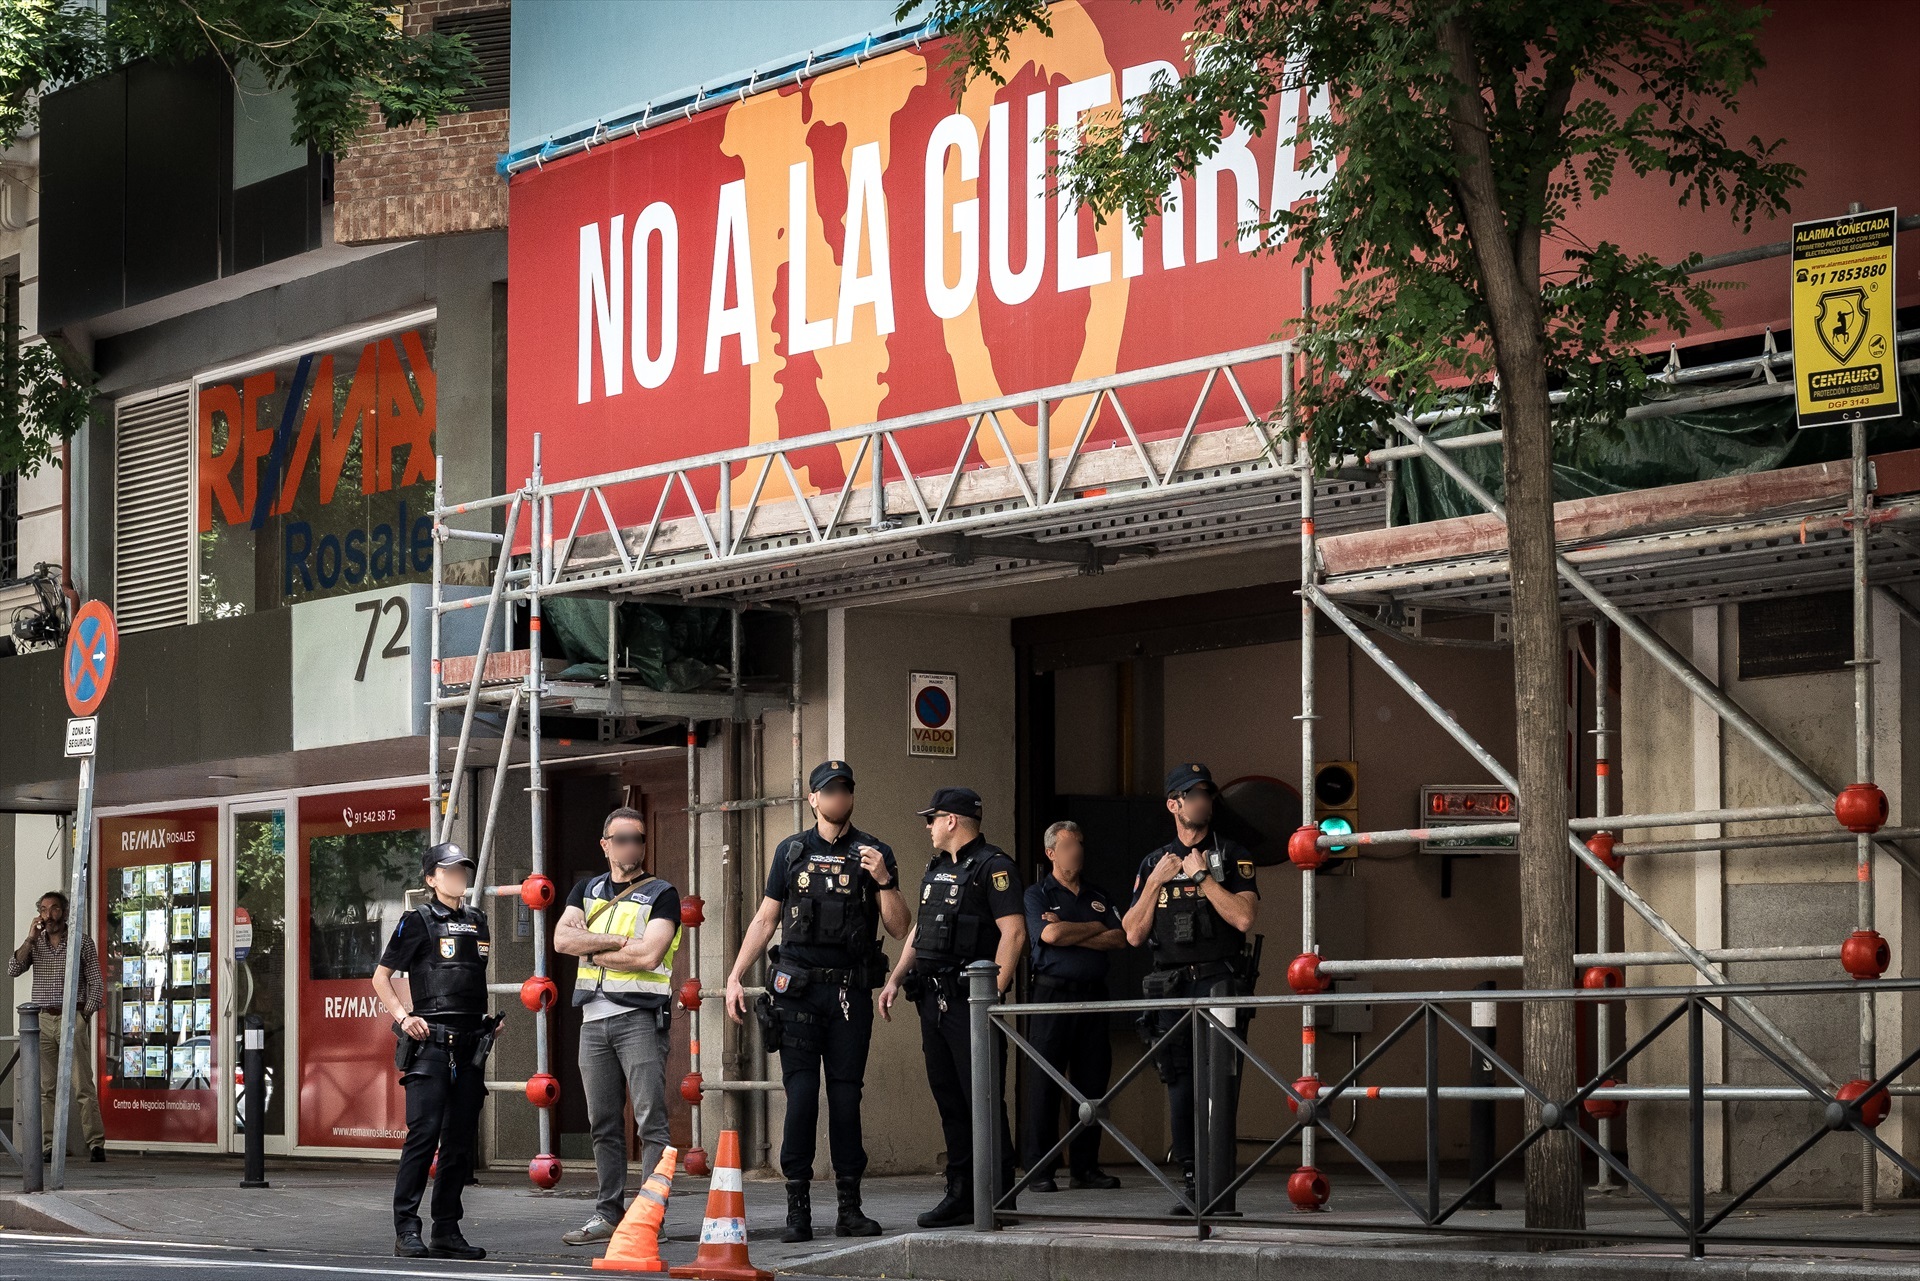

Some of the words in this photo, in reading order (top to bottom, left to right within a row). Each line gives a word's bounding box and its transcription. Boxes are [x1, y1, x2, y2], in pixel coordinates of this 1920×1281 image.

[1795, 227, 1835, 243] ALARMA
[1836, 217, 1890, 237] CONECTADA
[1826, 237, 1856, 247] PROTEGIDO
[1856, 235, 1869, 243] CON
[1869, 231, 1890, 241] SISTEMA
[1841, 244, 1849, 252] DE
[1849, 240, 1880, 251] SEGURIDAD
[577, 201, 679, 405] NO
[704, 178, 759, 376] A
[788, 141, 896, 356] LA
[1811, 272, 1826, 287] 91
[1830, 262, 1887, 284] 7853880
[1811, 367, 1880, 389] CENTAURO
[1813, 386, 1846, 398] PROTECCIÓN
[1845, 386, 1850, 394] Y
[1850, 382, 1881, 394] SEGURIDAD
[1828, 400, 1848, 409] DGP
[1850, 397, 1870, 407] 3143
[197, 330, 436, 533] RE/MAX
[355, 595, 410, 682] 72
[72, 727, 83, 736] ZONA
[84, 726, 91, 735] DE
[913, 729, 953, 743] VADO
[68, 737, 92, 748] SEGURIDAD
[354, 812, 362, 824] 91
[363, 811, 376, 823] 542
[377, 810, 386, 822] 58
[387, 809, 396, 821] 75
[121, 828, 166, 851] RE/MAX
[166, 830, 196, 844] ROSALES
[324, 996, 378, 1019] RE/MAX
[113, 1098, 132, 1110] Centro
[132, 1099, 139, 1109] de
[140, 1099, 166, 1112] Negocios
[165, 1100, 201, 1111] Inmobiliarios
[332, 1126, 408, 1139] www.remaxrosales.com
